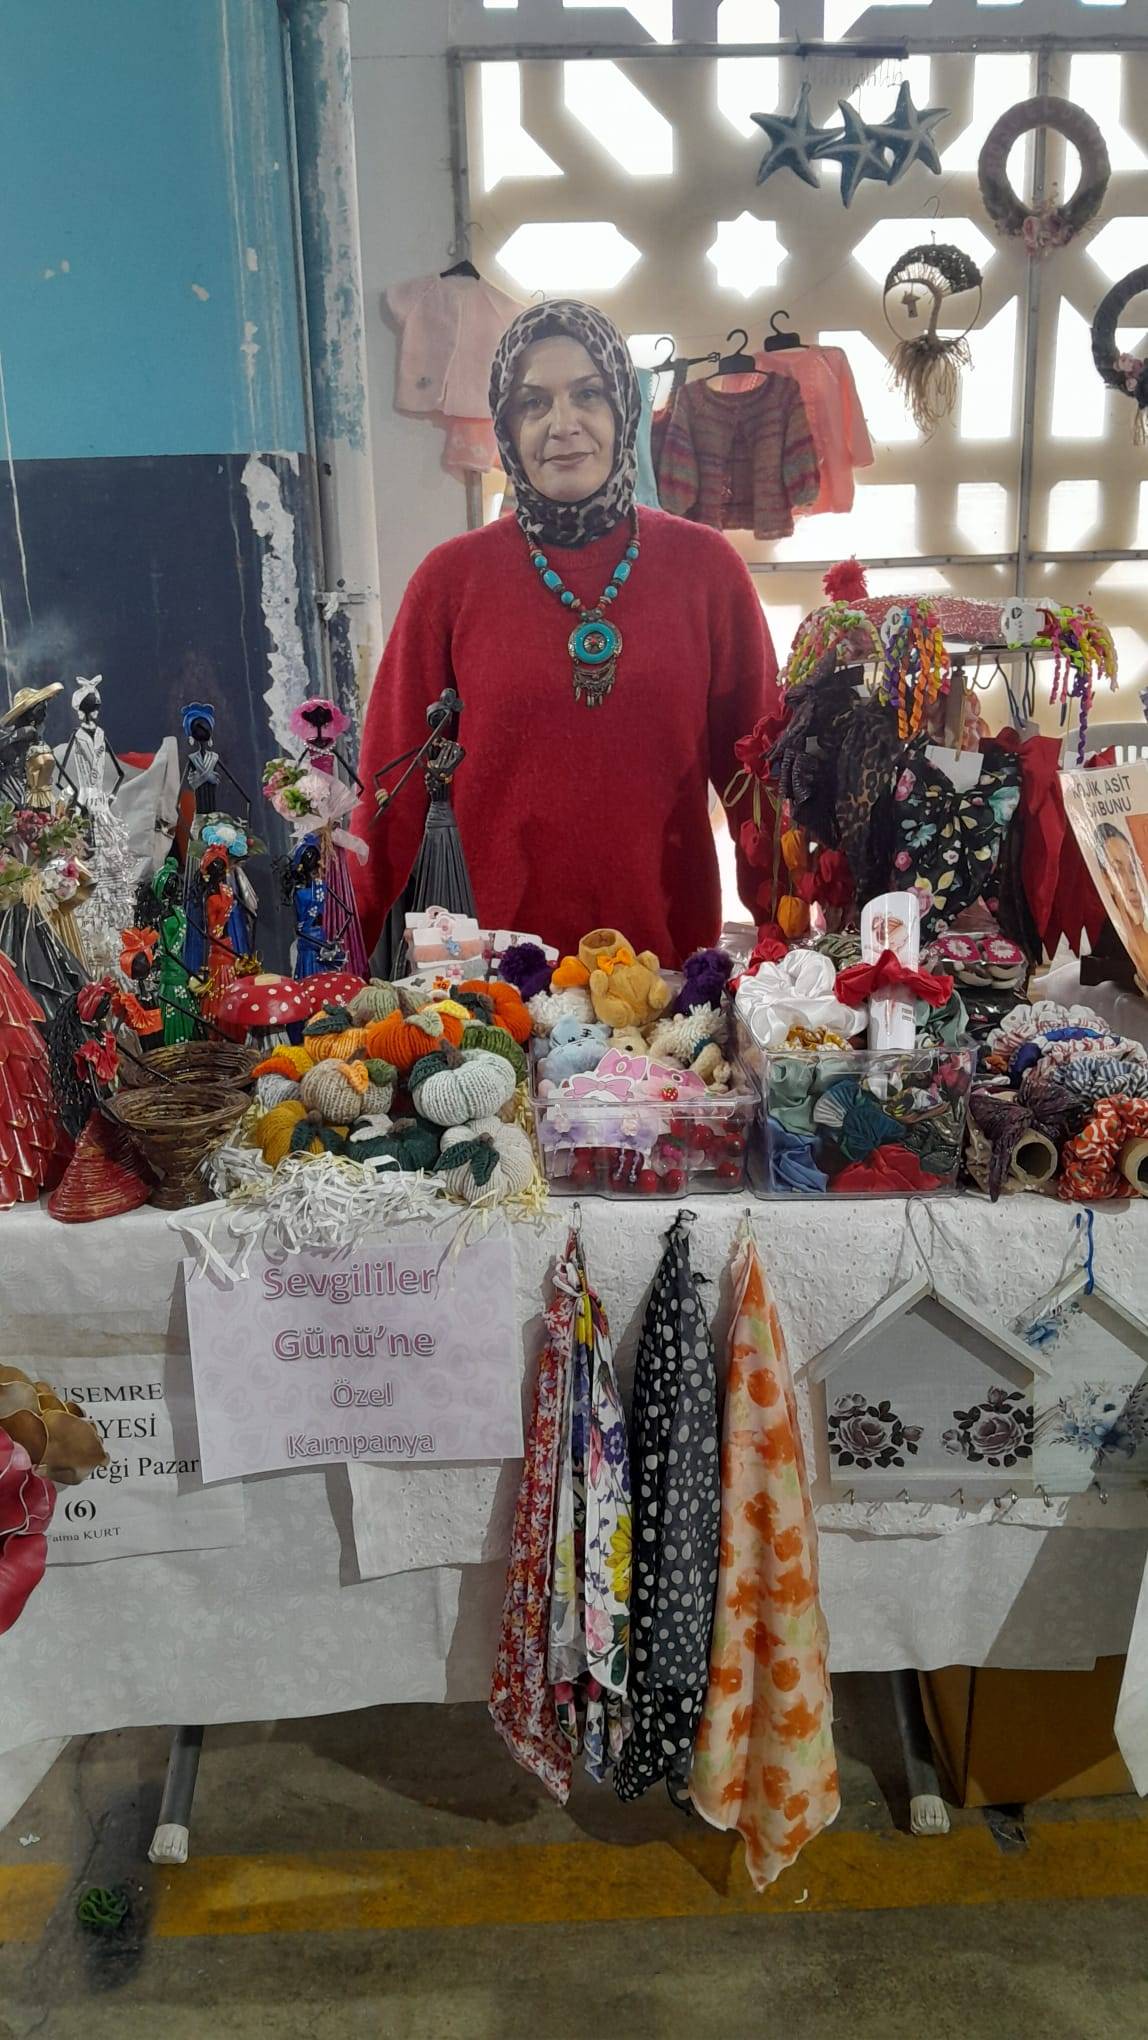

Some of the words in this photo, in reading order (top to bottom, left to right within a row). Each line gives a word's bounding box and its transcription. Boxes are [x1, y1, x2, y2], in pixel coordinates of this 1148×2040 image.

[1104, 773, 1131, 794] ASİT
[1086, 796, 1131, 817] SABUNU
[263, 1260, 436, 1304] Sevgililer
[273, 1325, 435, 1361] Günü'ne
[331, 1378, 394, 1407] Özel
[89, 1413, 157, 1439] YESİ
[287, 1433, 436, 1459] Kampanya
[90, 1457, 129, 1484] eği
[138, 1457, 200, 1476] Pazar
[65, 1499, 96, 1522] (6)
[50, 1534, 80, 1542] atma
[83, 1527, 121, 1540] KURT
